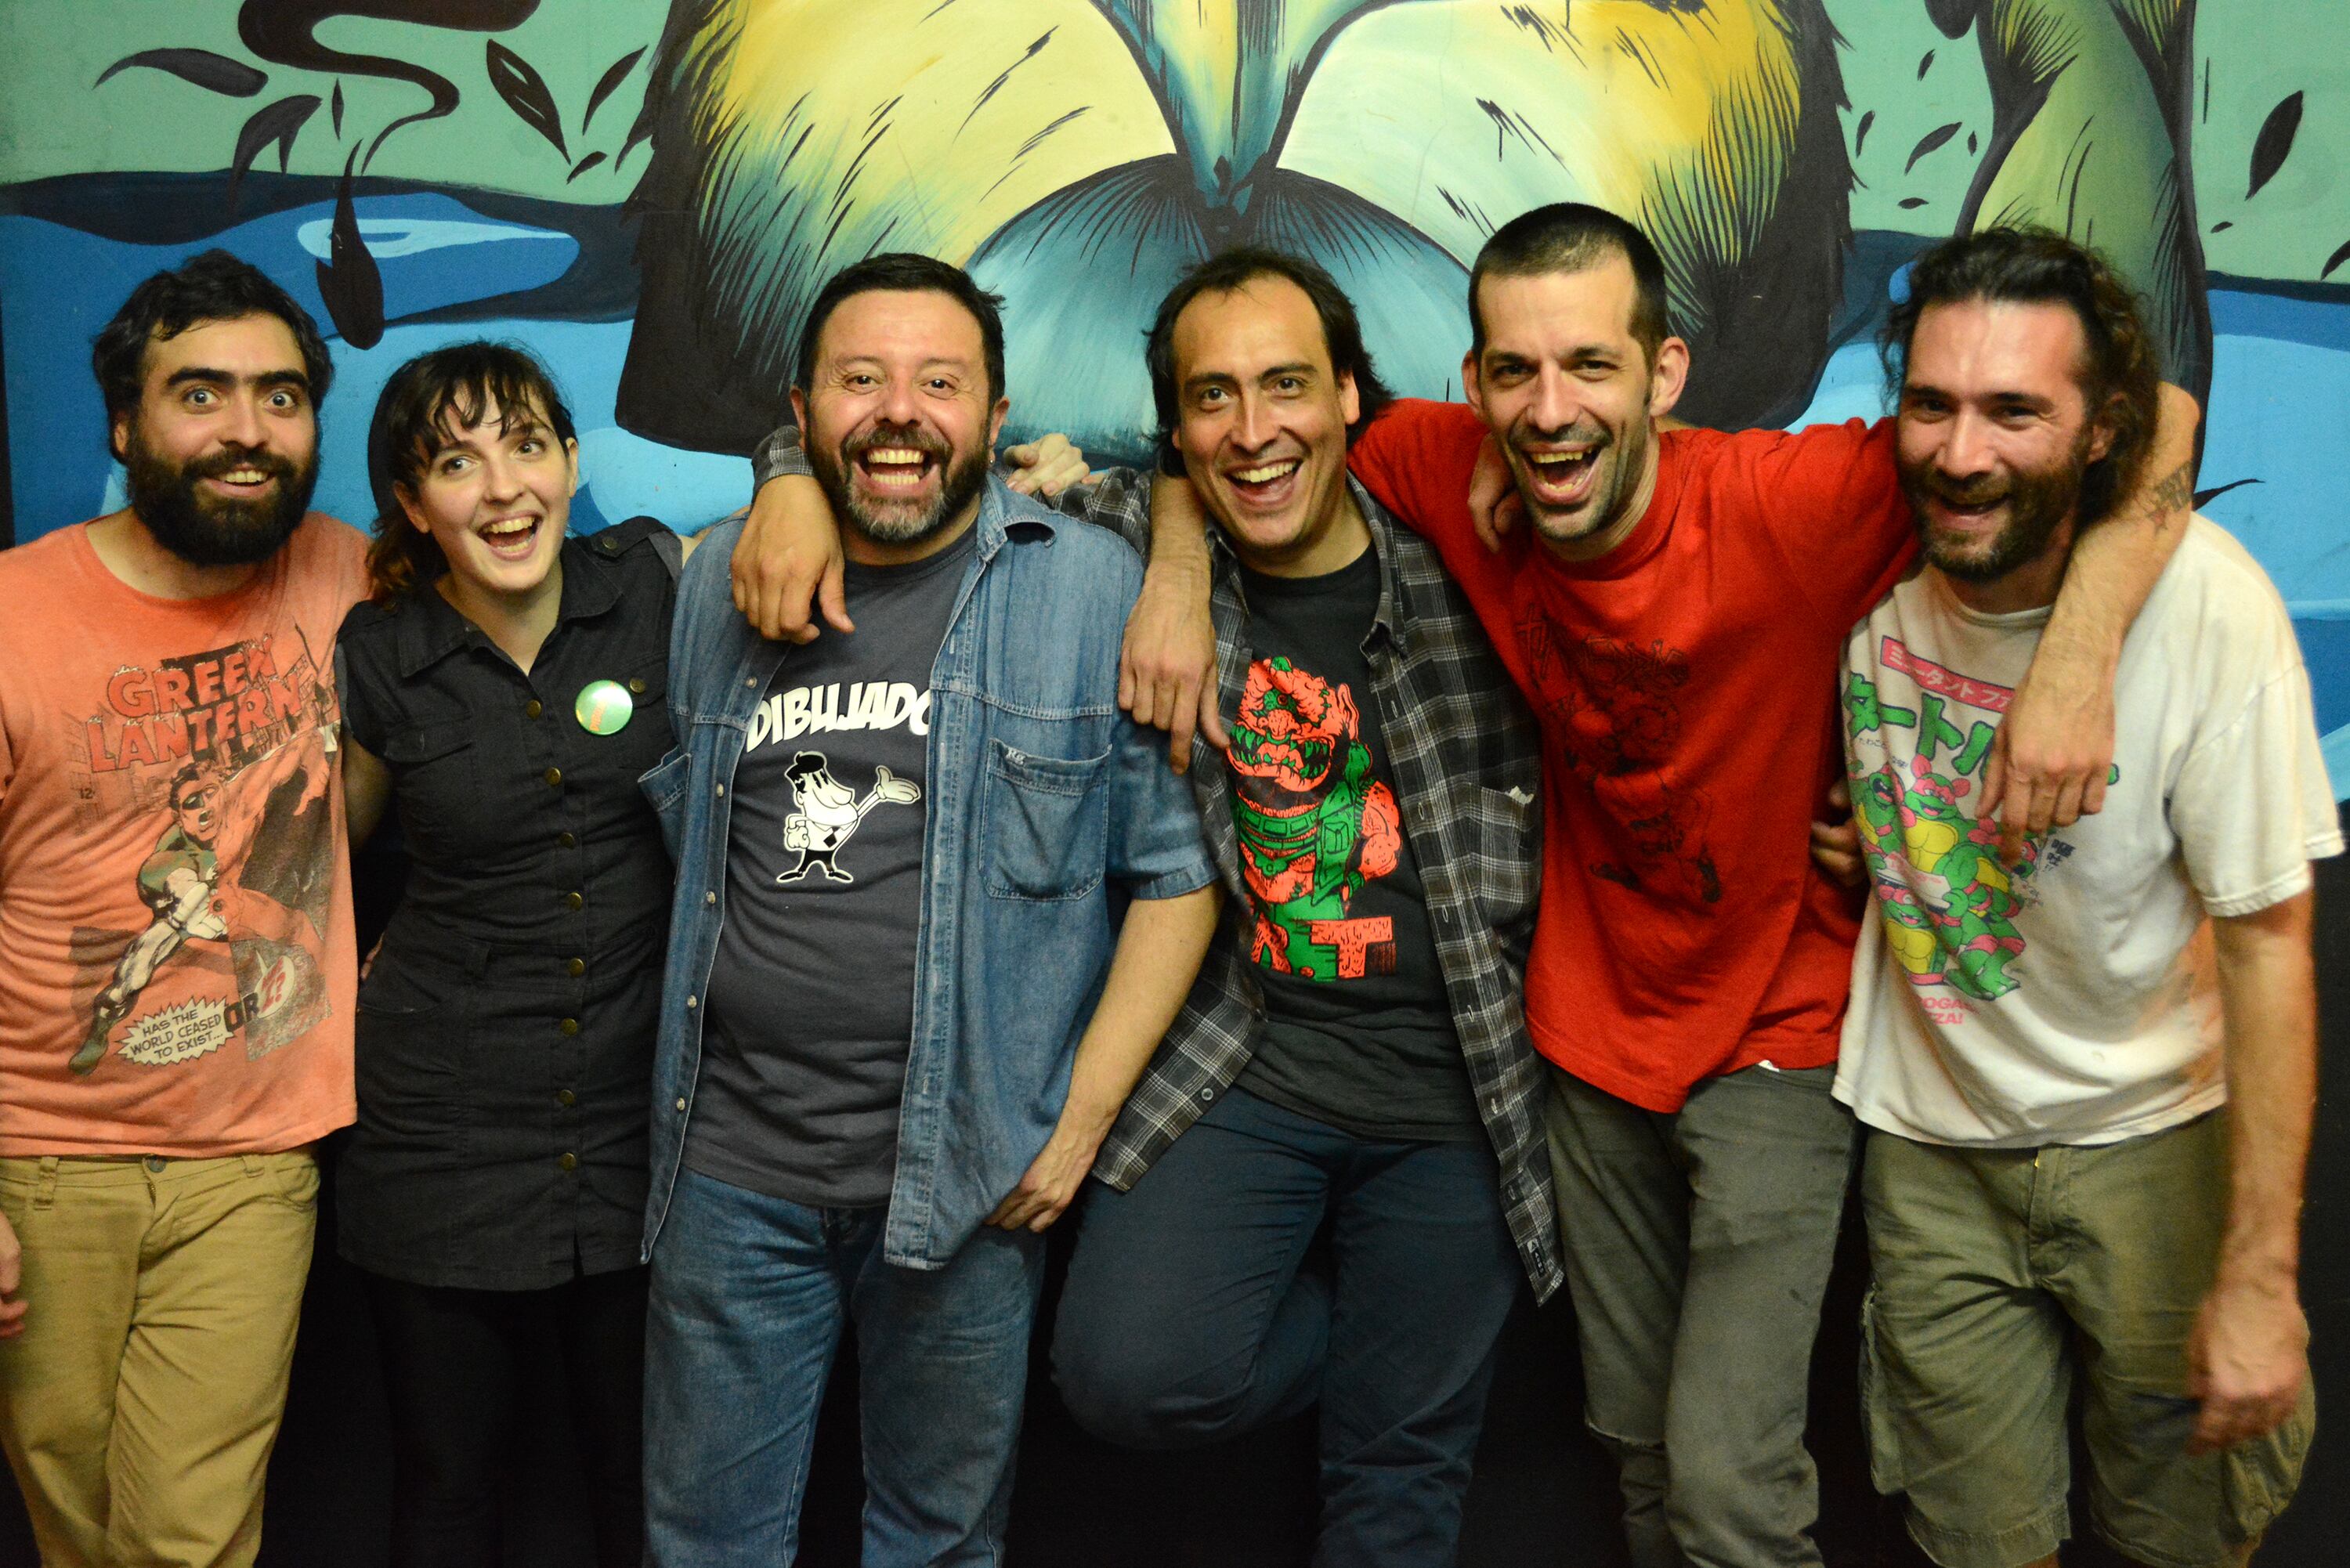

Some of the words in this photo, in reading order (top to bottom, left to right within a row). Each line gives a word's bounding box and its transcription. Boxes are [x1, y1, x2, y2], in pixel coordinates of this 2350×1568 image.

[107, 634, 276, 718] GREEN
[86, 670, 303, 773] LANTERN
[142, 1018, 172, 1038] HAS
[172, 1008, 199, 1025] THE
[222, 991, 260, 1033] OR
[130, 1029, 175, 1056] WORLD
[178, 1013, 222, 1039] CEASED
[154, 1046, 173, 1059] TO
[177, 1031, 223, 1053] EXIST...
